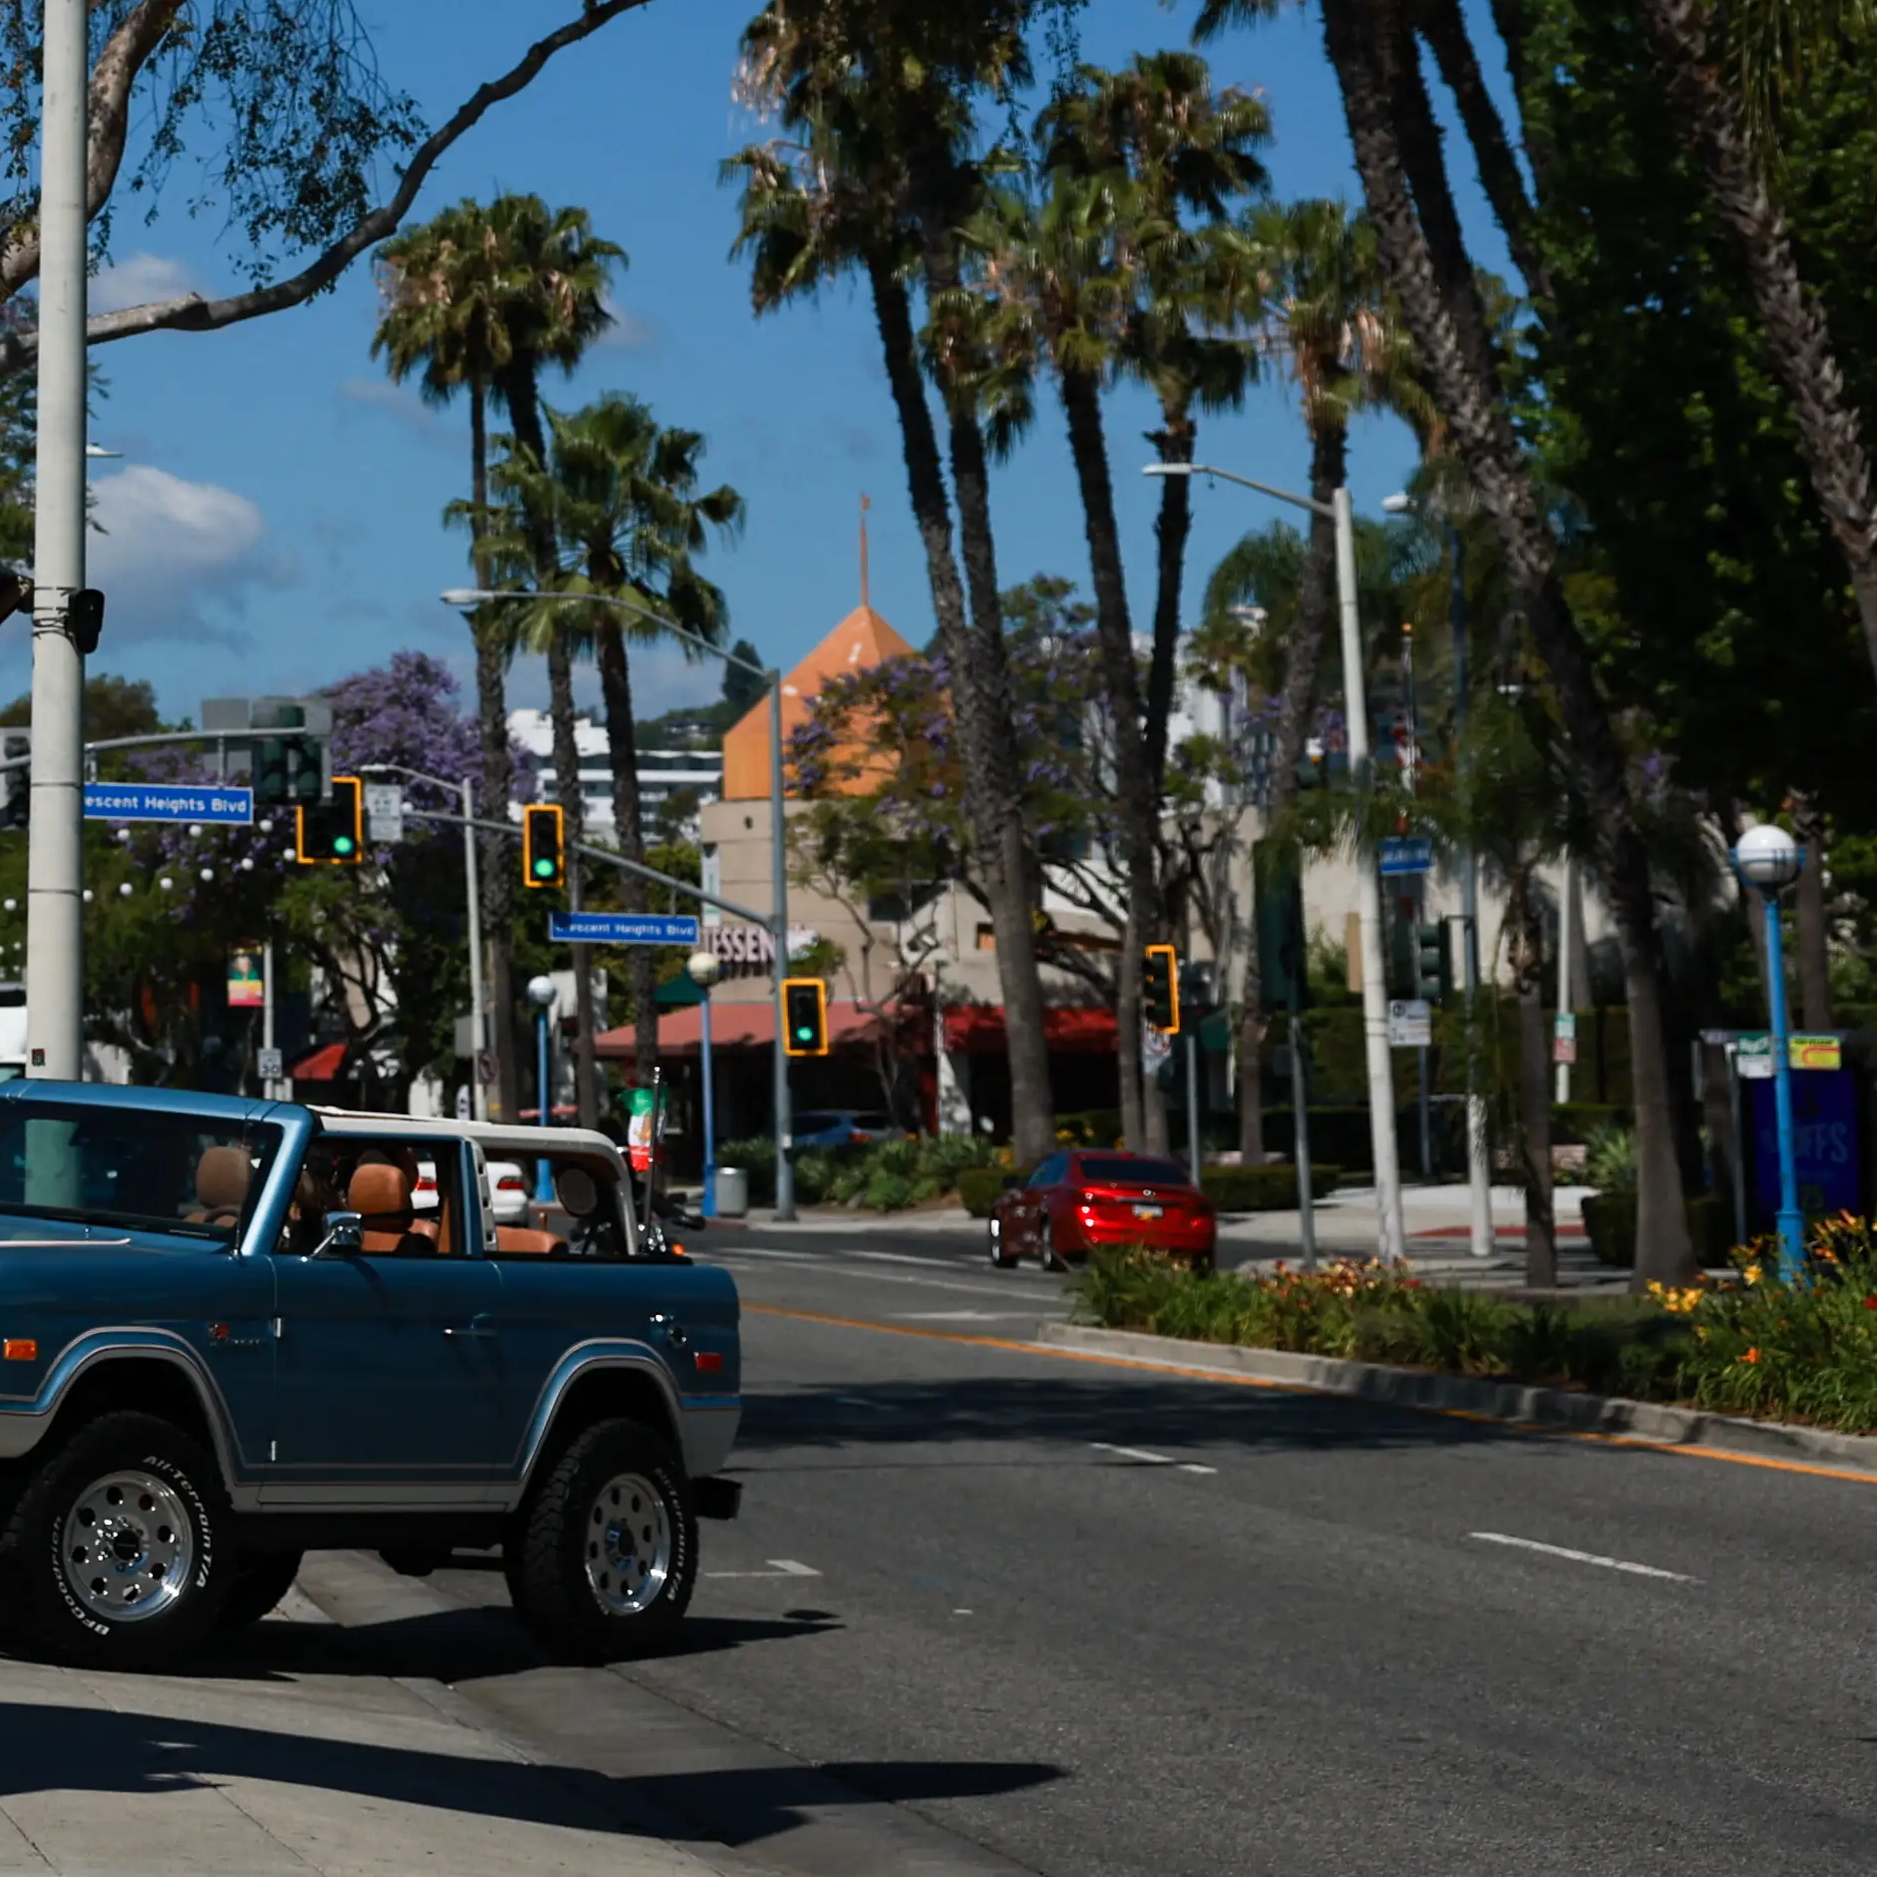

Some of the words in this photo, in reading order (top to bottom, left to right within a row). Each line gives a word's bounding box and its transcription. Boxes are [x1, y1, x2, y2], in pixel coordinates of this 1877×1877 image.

[84, 795, 139, 810] escent
[145, 796, 206, 815] Heights
[211, 797, 247, 814] Blvd
[50, 1515, 111, 1636] BFGoodrich
